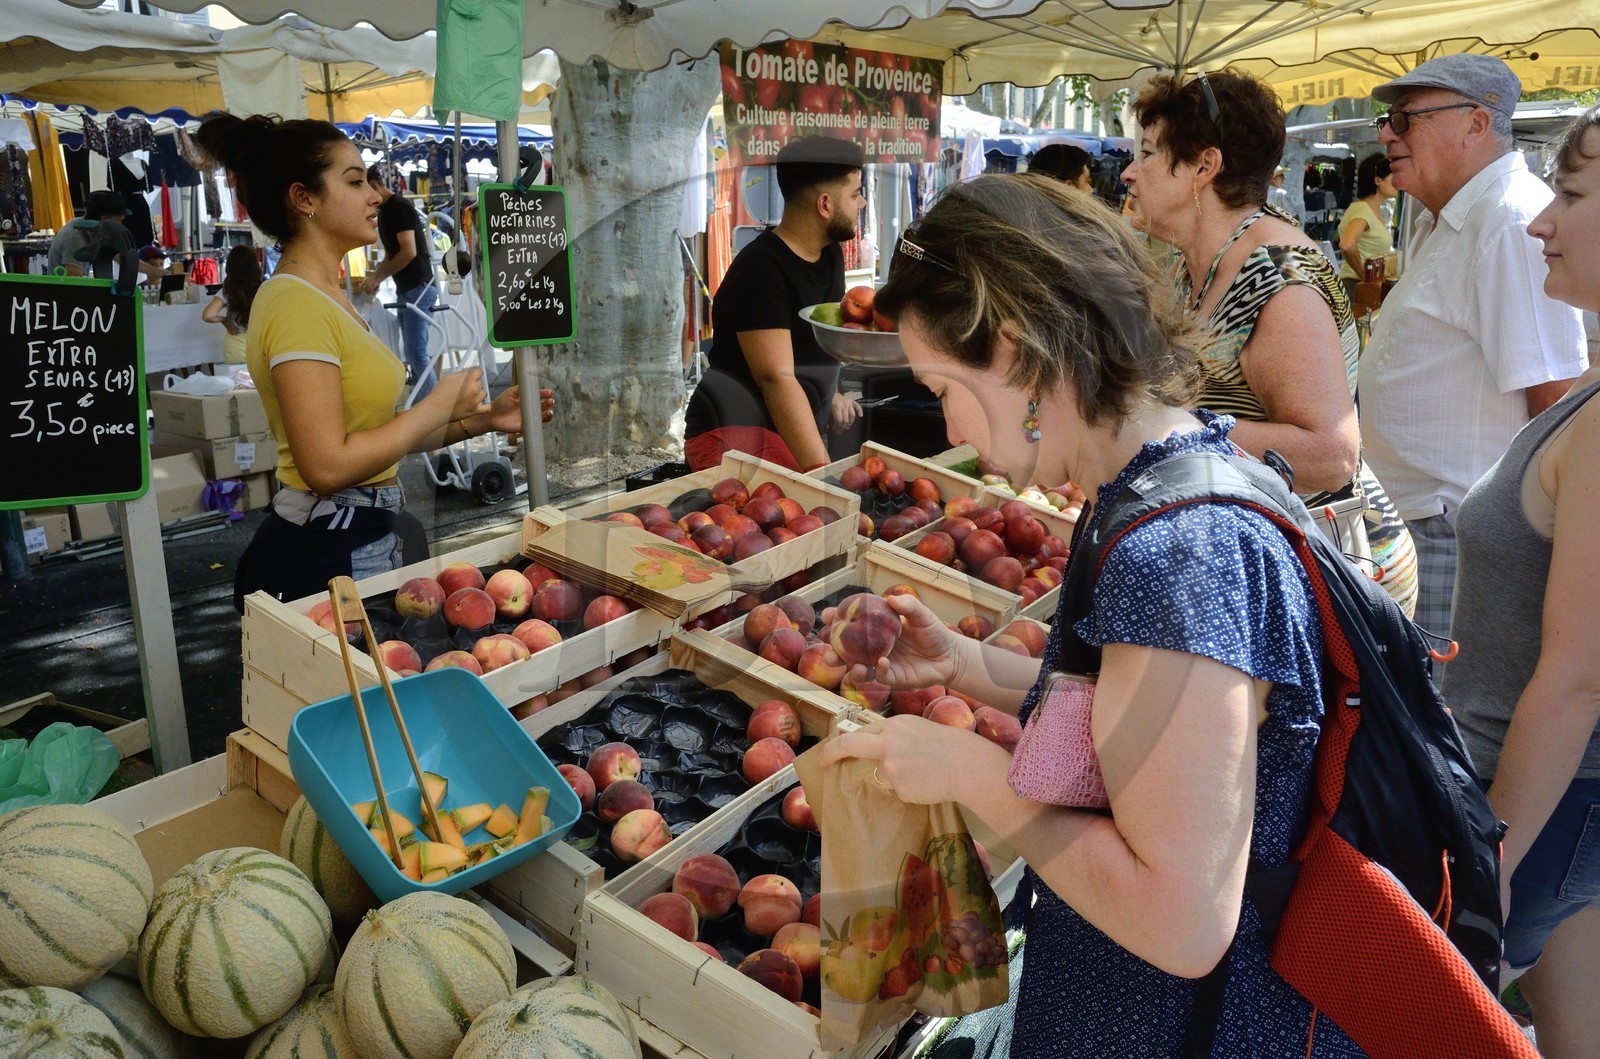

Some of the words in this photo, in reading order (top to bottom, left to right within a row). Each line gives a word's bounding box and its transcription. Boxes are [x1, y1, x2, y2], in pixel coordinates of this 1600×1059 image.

[731, 44, 819, 85] Tomate
[825, 53, 849, 86] de
[854, 57, 932, 94] Provence
[736, 103, 787, 127] Culture
[790, 108, 851, 129] raisonnée
[854, 110, 868, 129] de
[870, 112, 901, 132] pleine
[904, 115, 930, 131] terre
[747, 134, 780, 156] dans
[865, 137, 875, 155] la
[877, 138, 922, 155] tradition
[548, 228, 567, 251] (13)
[10, 296, 117, 335] MELON
[545, 298, 551, 309] 2
[24, 370, 99, 389] SENAS
[104, 364, 136, 396] (13)
